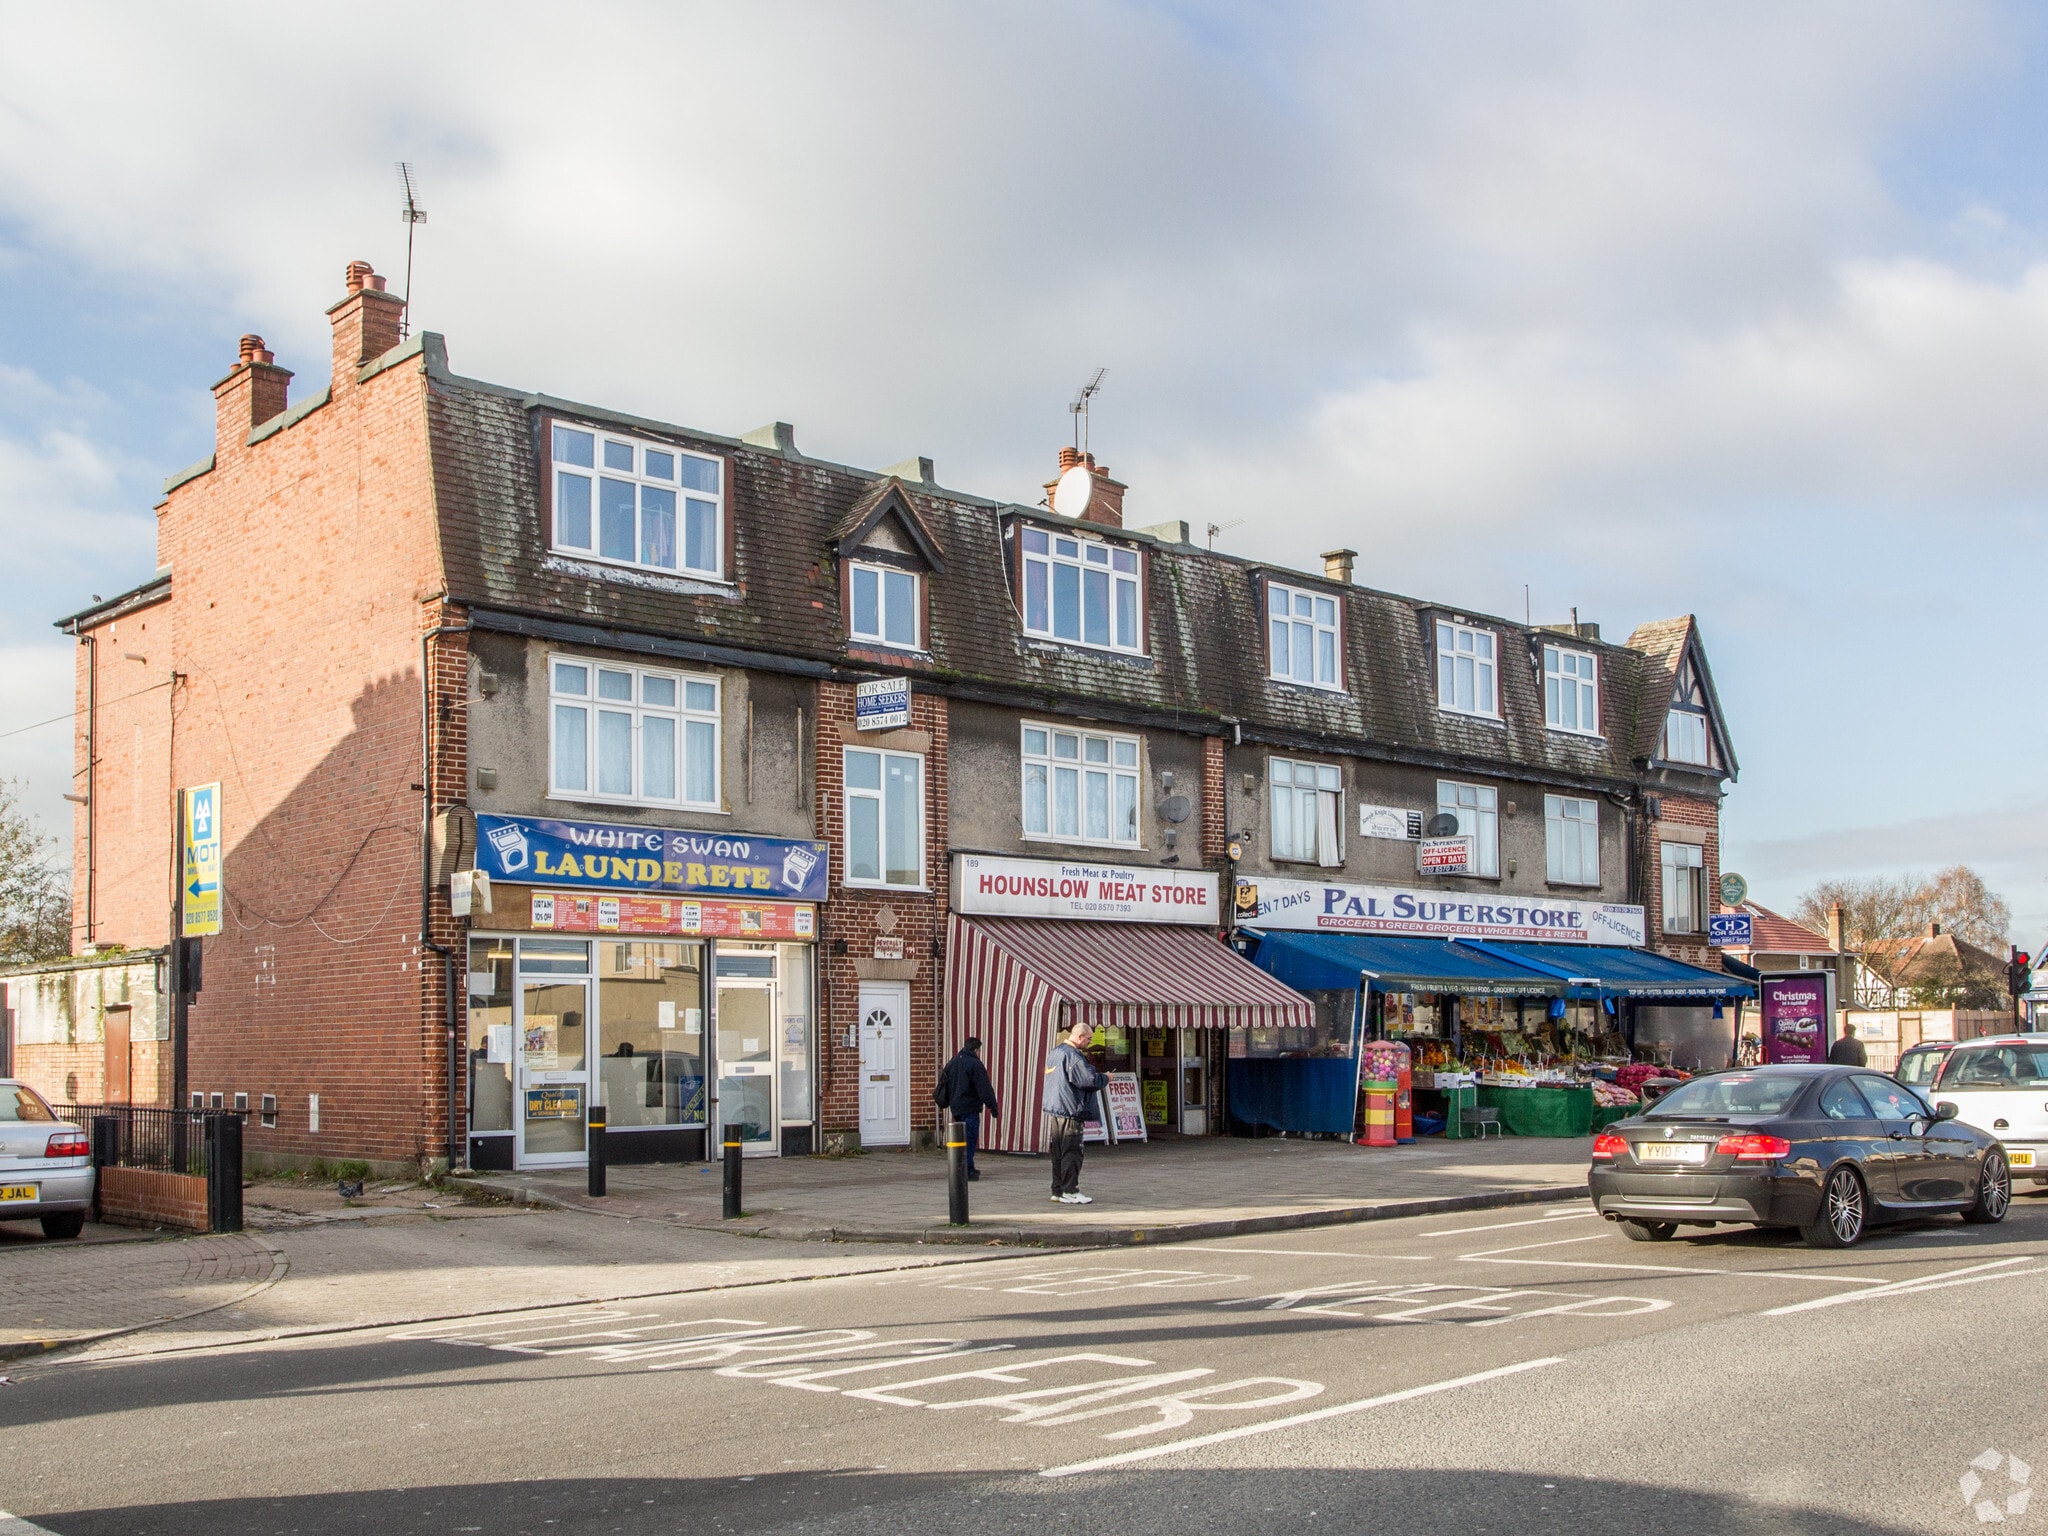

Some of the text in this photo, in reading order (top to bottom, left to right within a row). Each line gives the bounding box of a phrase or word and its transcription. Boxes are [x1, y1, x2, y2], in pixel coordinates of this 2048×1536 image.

[858, 680, 904, 696] FOR SALE
[858, 692, 906, 708] HOME SEEKERS
[858, 718, 870, 728] 020
[872, 716, 888, 726] 8574
[569, 826, 750, 860] WHITE SWAN
[812, 842, 826, 852] 191
[1423, 846, 1466, 854] OFF-LICENCE
[188, 843, 218, 866] MOT
[1423, 854, 1466, 864] OPEN 7 DAYS
[534, 850, 772, 890] LAUNDERETE
[965, 858, 980, 868] 189
[1061, 866, 1135, 882] Fresh Meat & Poultry
[979, 874, 1207, 906] HOUNSLOW MEAT STORE
[1070, 902, 1132, 913] TEL 020 8570 7393
[1273, 898, 1280, 911] 7
[1282, 890, 1311, 909] DAYS
[1323, 888, 1582, 928] PAL SUPERSTORE
[186, 912, 194, 925] 020
[1592, 911, 1642, 942] OFF-LICENCE
[1726, 921, 1734, 931] H
[1320, 917, 1586, 940] GROCERS GREEN GROCERS WHOLESALE & RETAIL
[1773, 992, 1817, 1000] Christmas
[1108, 1082, 1136, 1096] FRESH
[529, 1099, 577, 1111] DRY CLEANING
[8, 1188, 30, 1198] JAL
[1216, 1280, 1674, 1327] KEEP
[386, 1310, 878, 1370] CLEAR
[715, 1338, 1326, 1442] CLEAR
